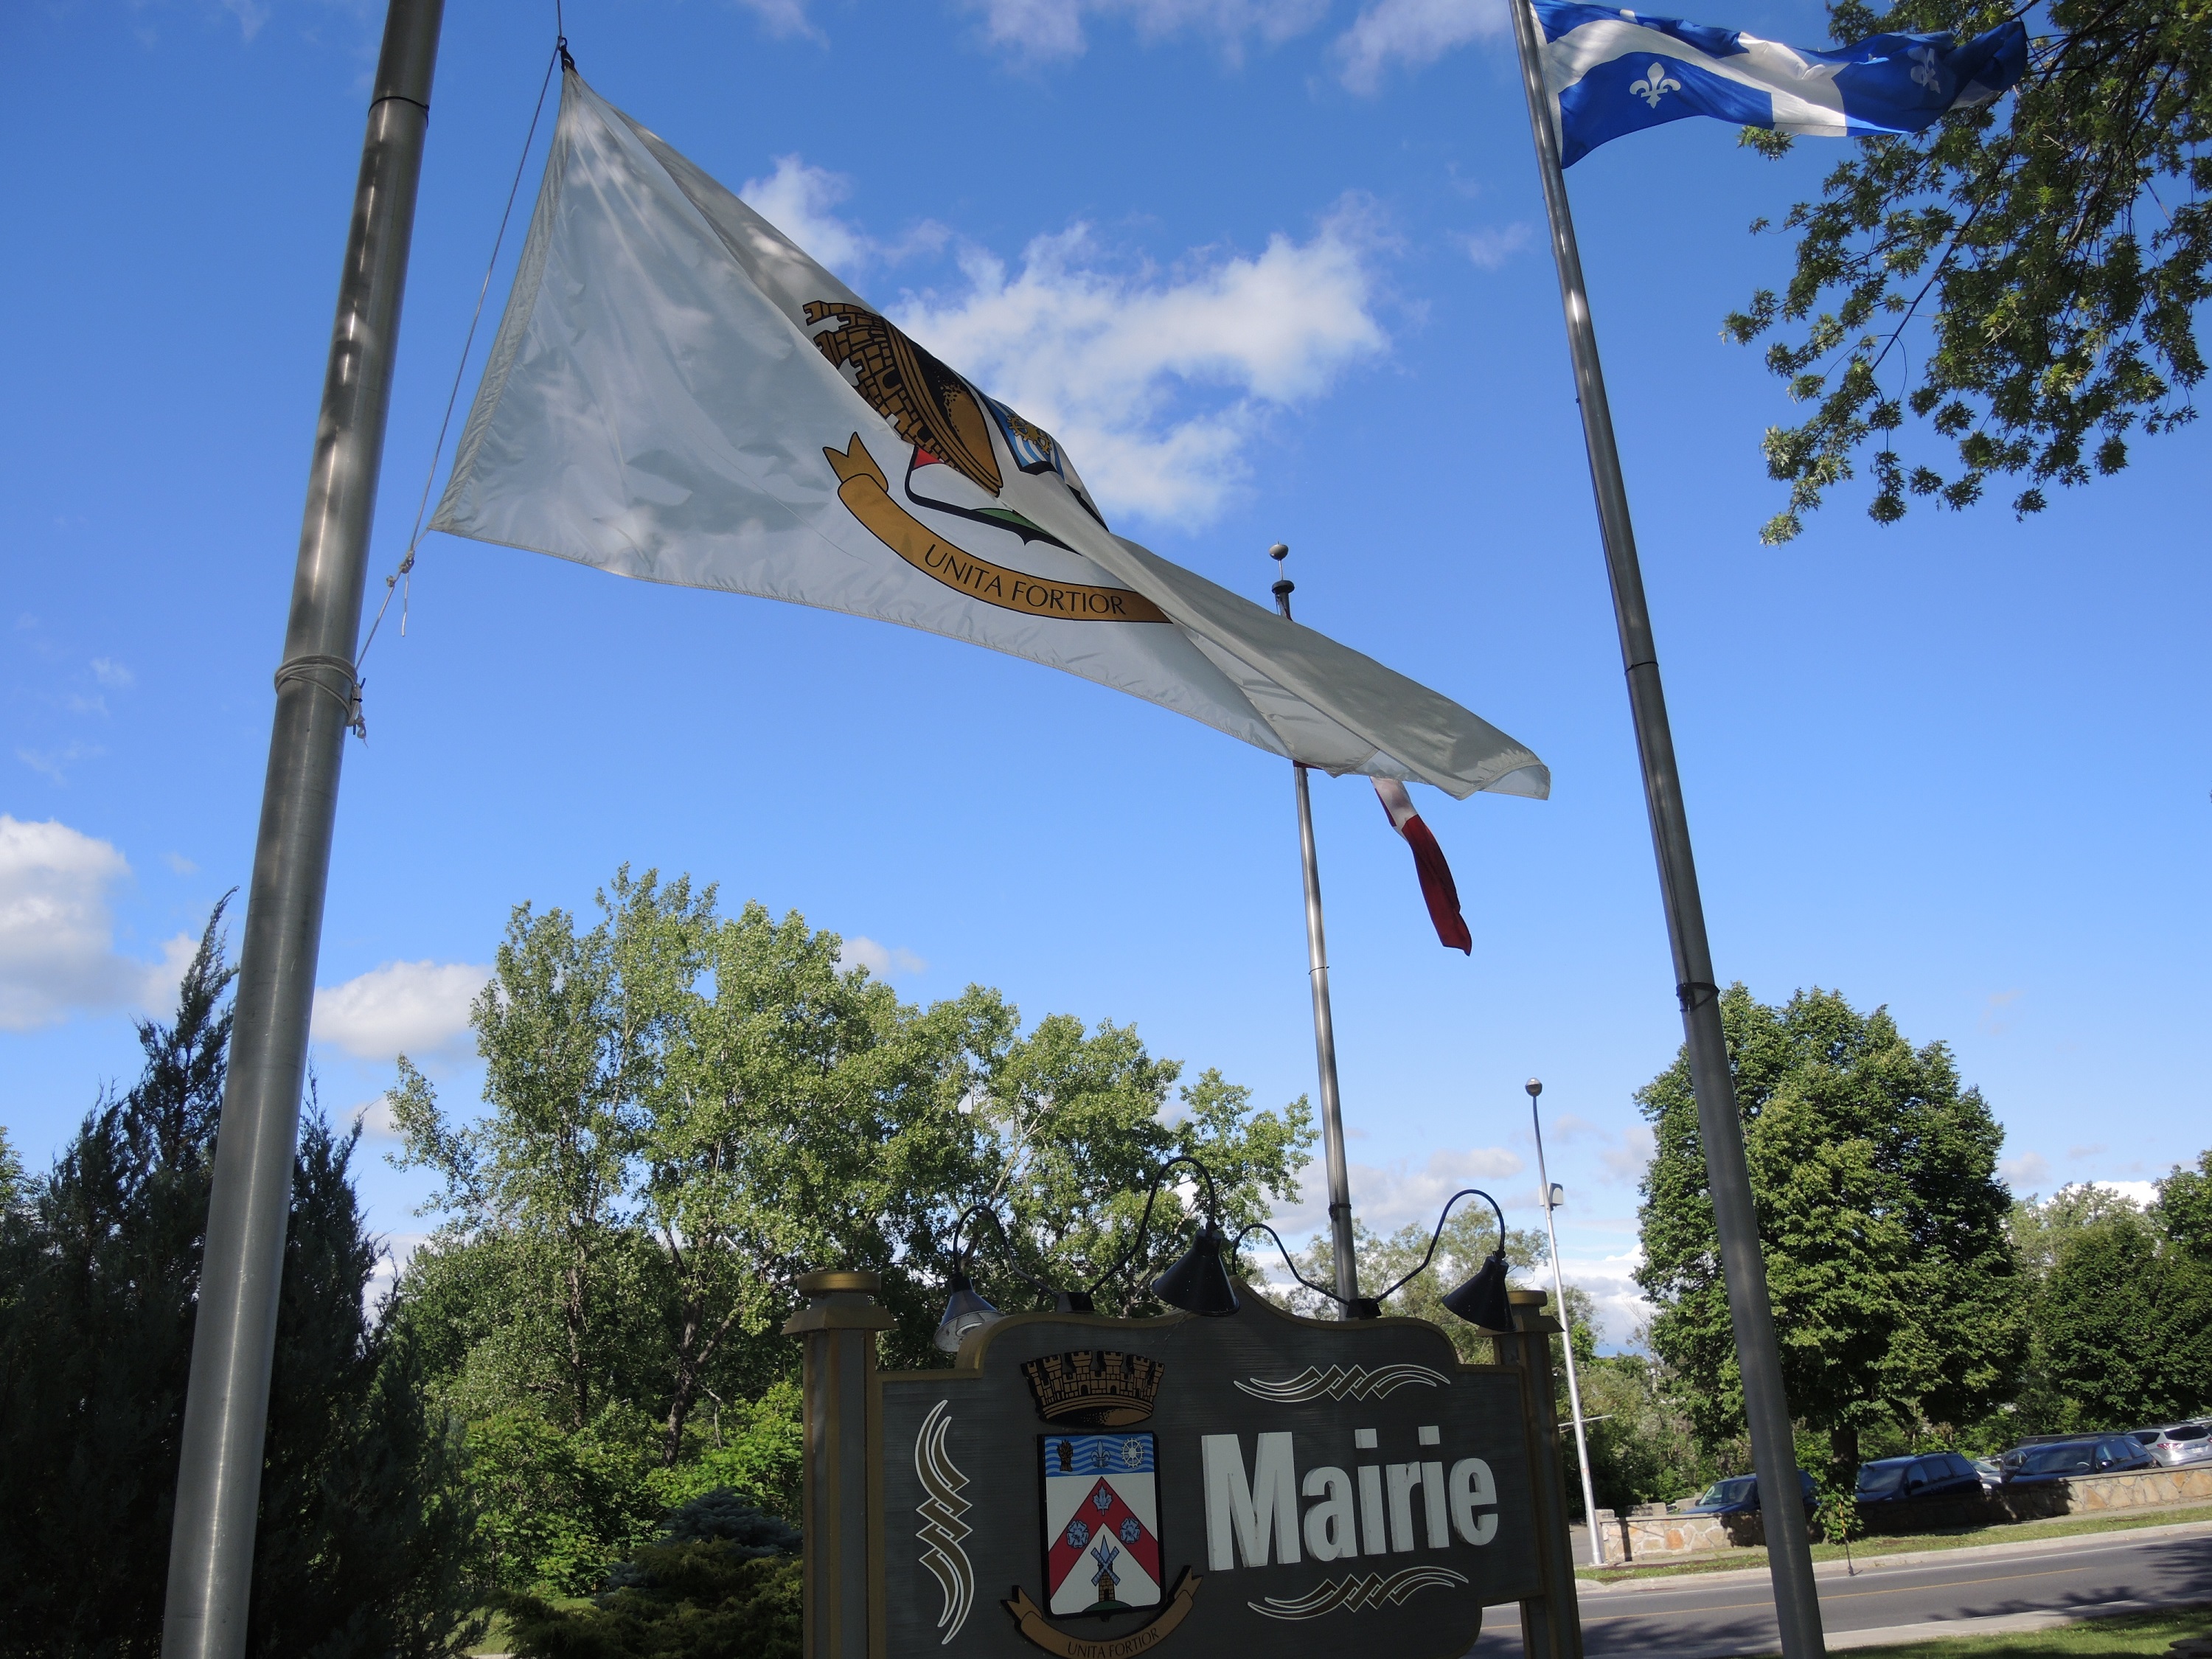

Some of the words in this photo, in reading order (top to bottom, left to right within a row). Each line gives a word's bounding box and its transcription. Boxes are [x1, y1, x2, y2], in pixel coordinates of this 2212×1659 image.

[925, 544, 1002, 597] UNITA
[1012, 581, 1126, 615] FORTIOR
[1201, 1425, 1498, 1571] Mairie
[1068, 1641, 1106, 1659] UNITA
[1110, 1628, 1160, 1658] FORTIOR
